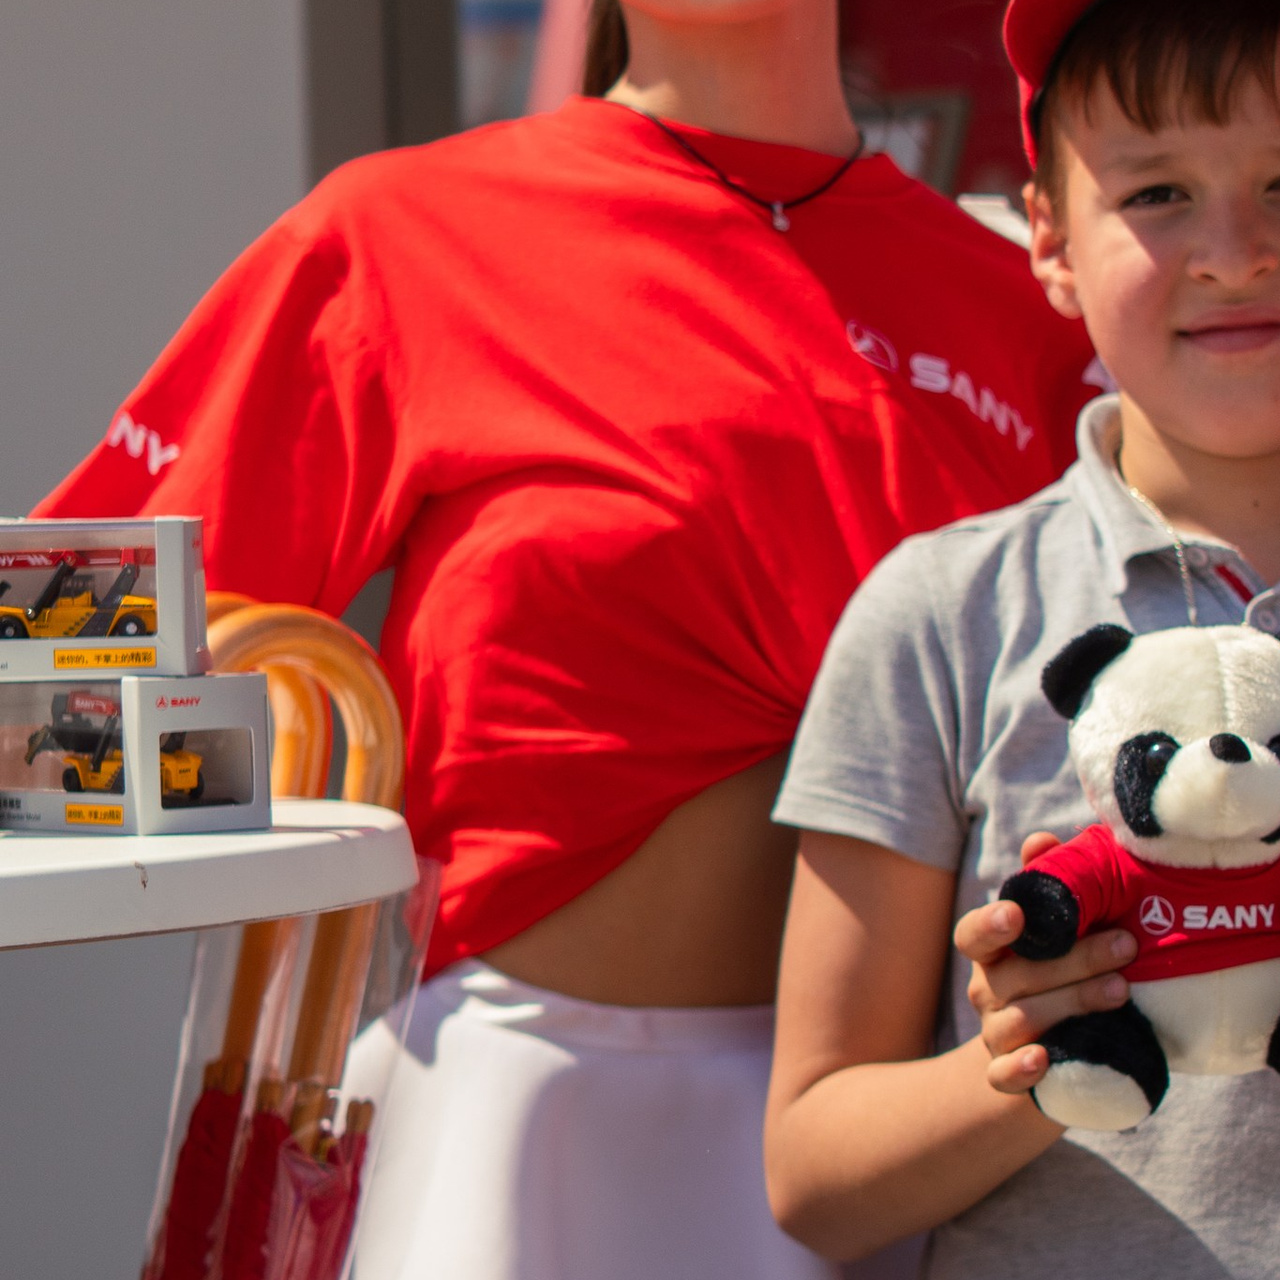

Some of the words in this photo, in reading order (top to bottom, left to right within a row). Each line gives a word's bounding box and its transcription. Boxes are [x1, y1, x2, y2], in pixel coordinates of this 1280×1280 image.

[909, 352, 1034, 451] SANY
[106, 411, 181, 476] NY
[170, 696, 201, 707] SANY
[1183, 903, 1275, 929] SANY
